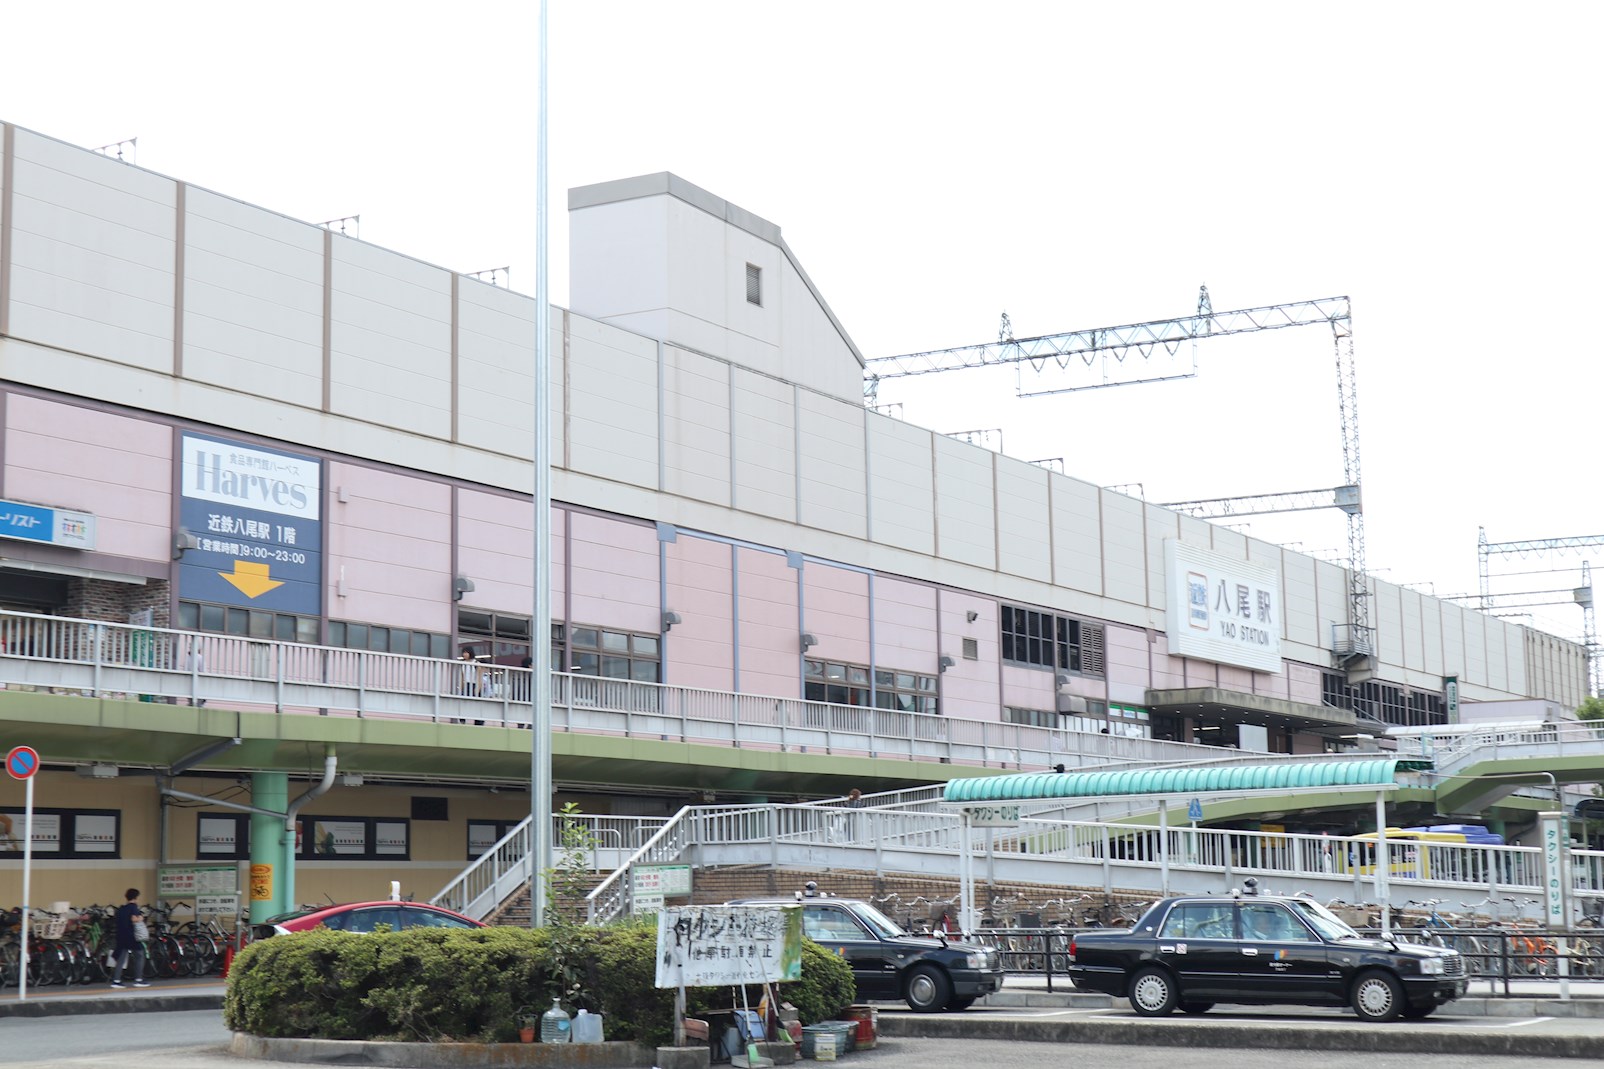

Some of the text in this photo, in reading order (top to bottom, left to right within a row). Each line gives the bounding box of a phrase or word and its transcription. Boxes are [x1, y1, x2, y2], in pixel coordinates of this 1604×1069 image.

[196, 450, 307, 510] Harves
[208, 513, 296, 545] 近鉄八尾駅 1階
[1214, 579, 1272, 624] 八尾駅
[1220, 621, 1269, 646] YAO STATION
[1547, 830, 1561, 915] タクシーのりば
